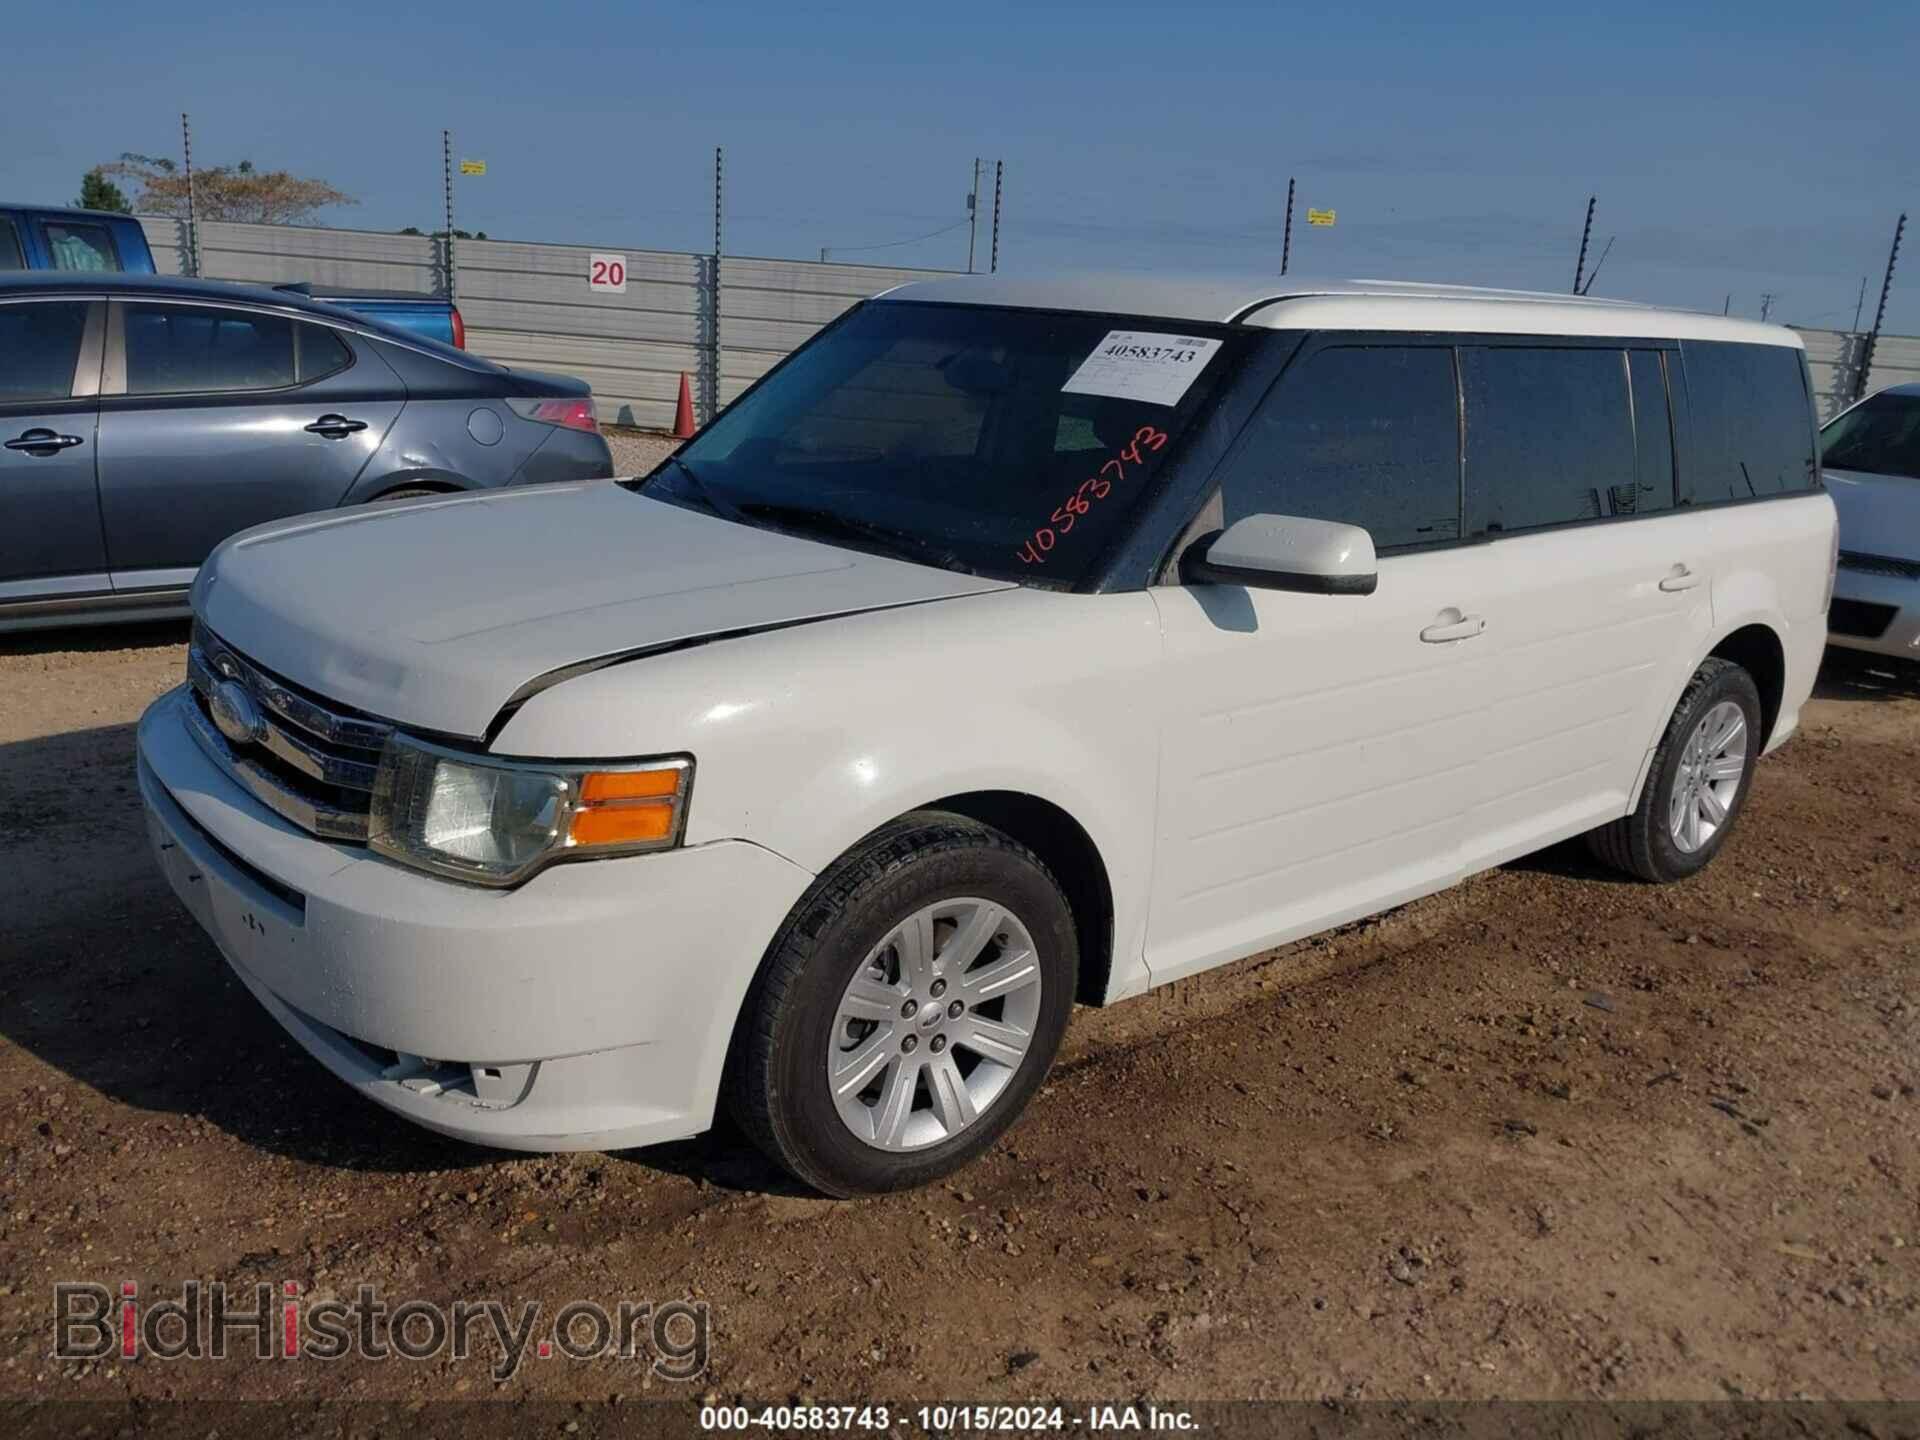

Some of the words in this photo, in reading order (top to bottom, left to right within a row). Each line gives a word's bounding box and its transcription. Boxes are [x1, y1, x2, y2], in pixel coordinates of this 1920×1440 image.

[592, 261, 624, 286] 20
[1104, 343, 1197, 363] 40583743
[1016, 426, 1168, 564] 40583743
